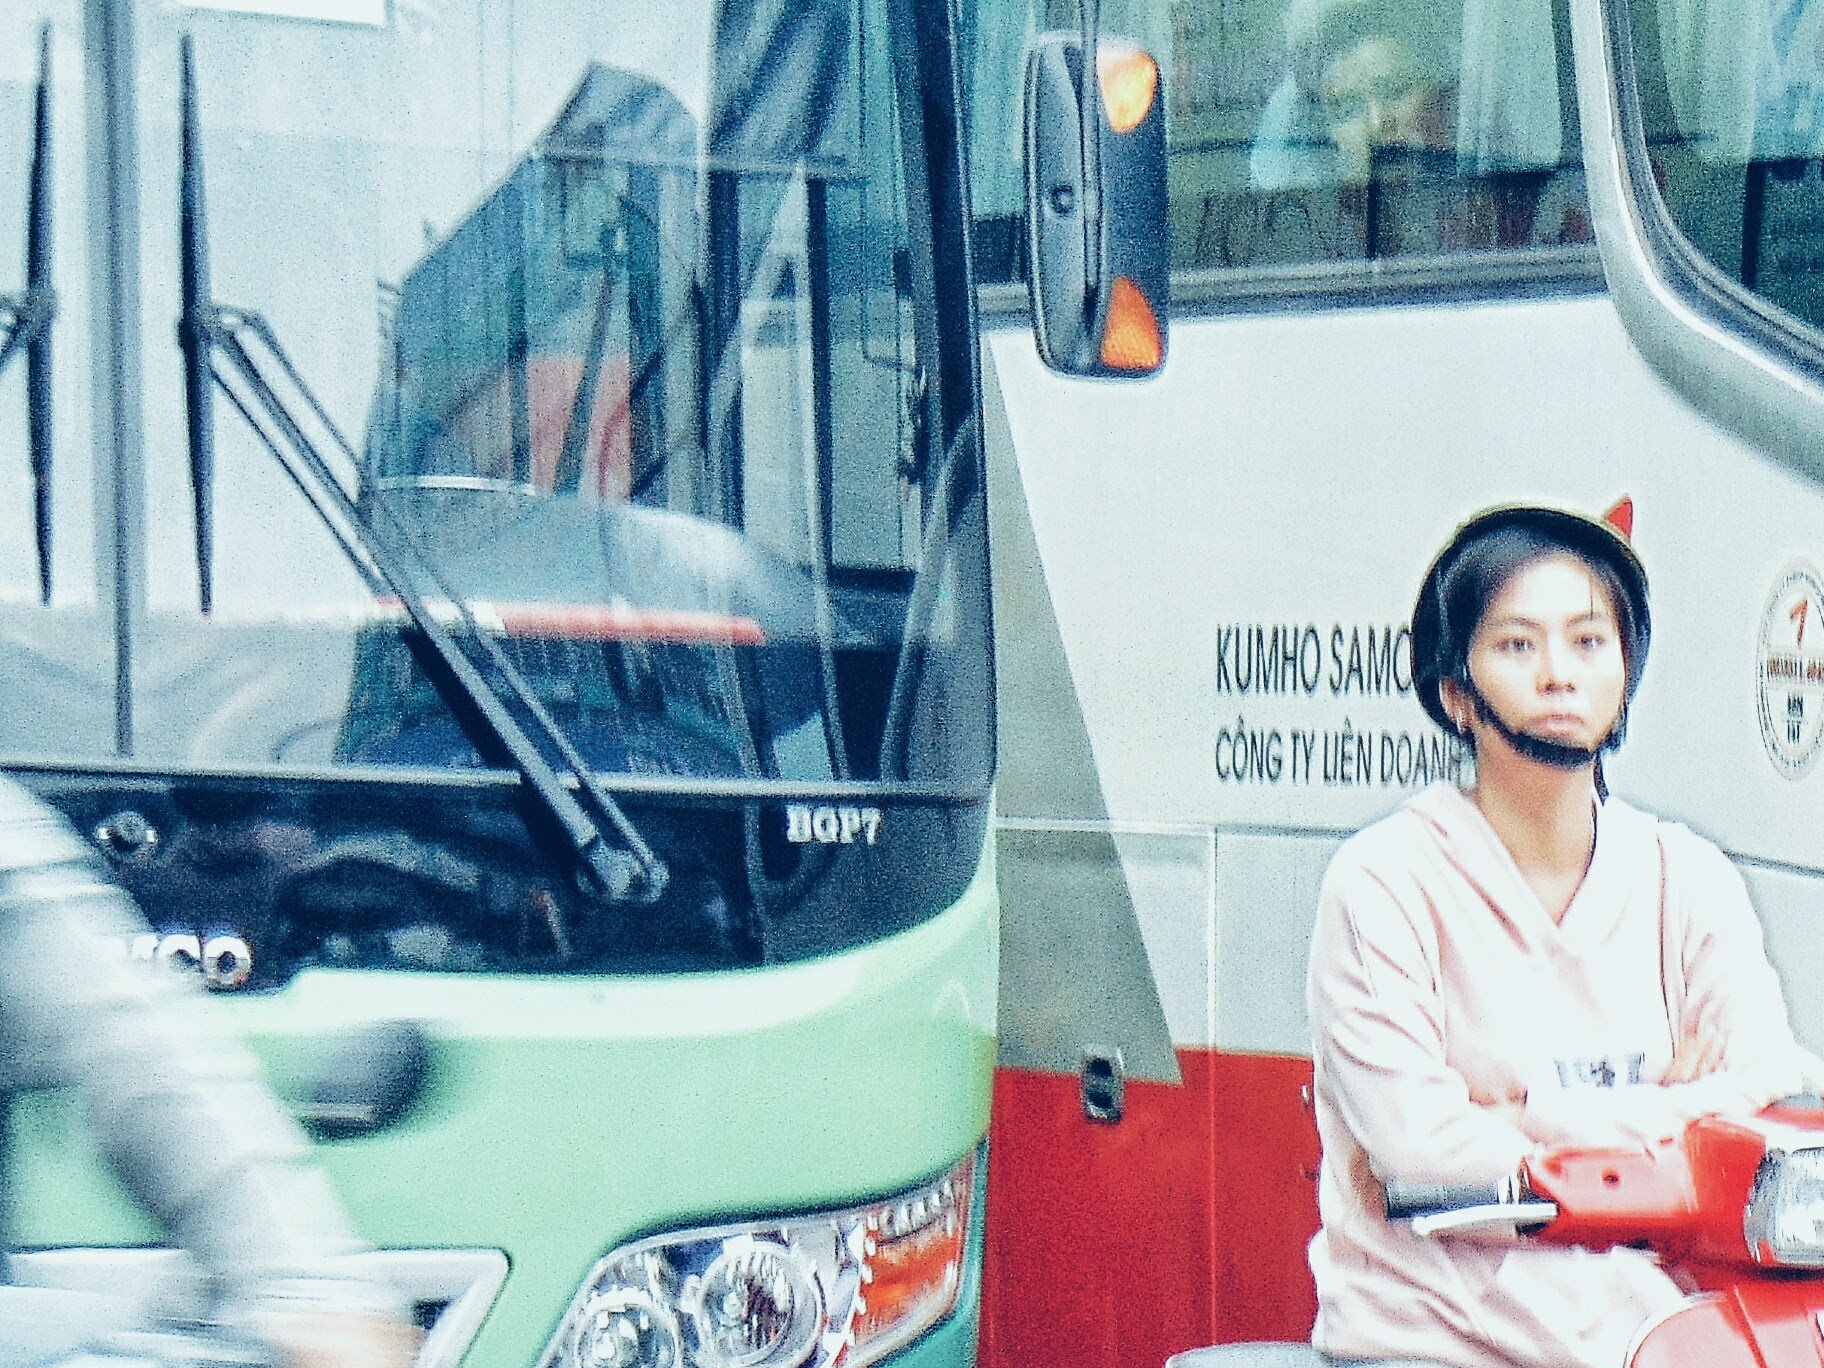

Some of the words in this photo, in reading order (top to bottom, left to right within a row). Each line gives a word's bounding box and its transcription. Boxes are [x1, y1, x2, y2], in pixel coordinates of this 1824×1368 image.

[1216, 623, 1321, 695] KUMHO
[1215, 715, 1283, 783] CÔNG
[1289, 729, 1315, 784] TY
[1323, 717, 1372, 787] LIÊN
